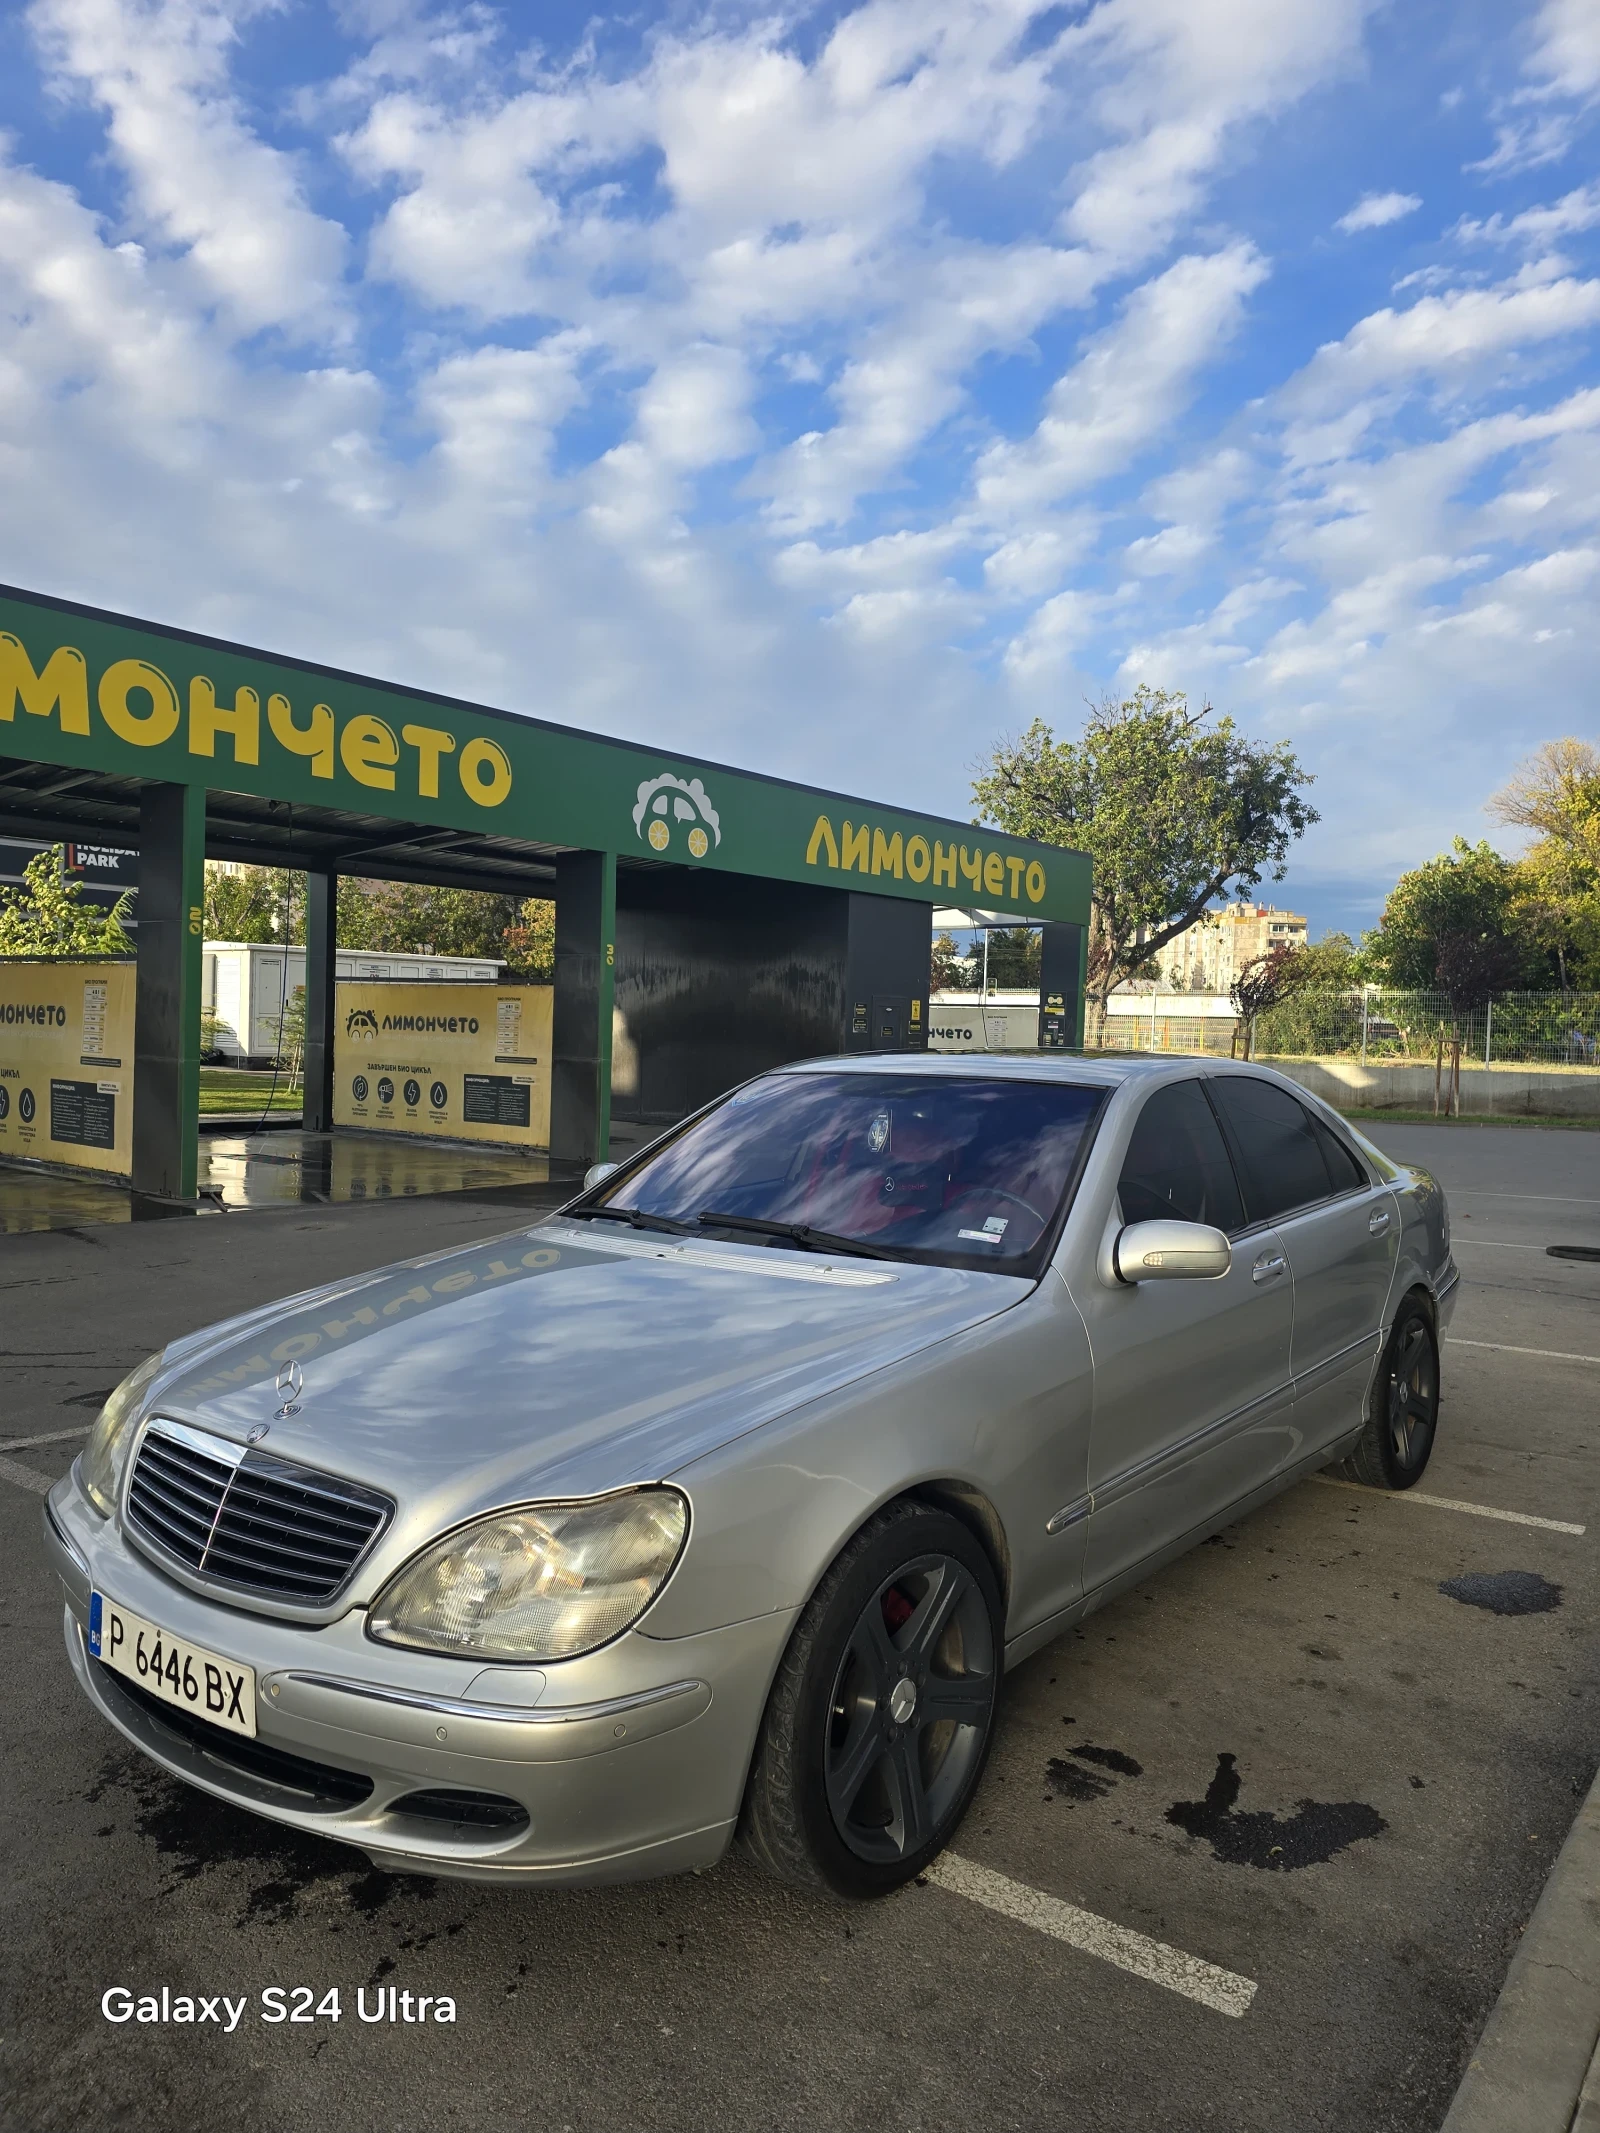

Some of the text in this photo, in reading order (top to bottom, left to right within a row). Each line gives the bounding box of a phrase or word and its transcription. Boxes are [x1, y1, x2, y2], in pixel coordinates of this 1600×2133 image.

[77, 852, 119, 868] PARK
[367, 1063, 432, 1075] ЗАВЪРШЕН БИО ЦИКЪЛ
[91, 1630, 101, 1647] BG
[110, 1613, 246, 1725] P 6446 BX
